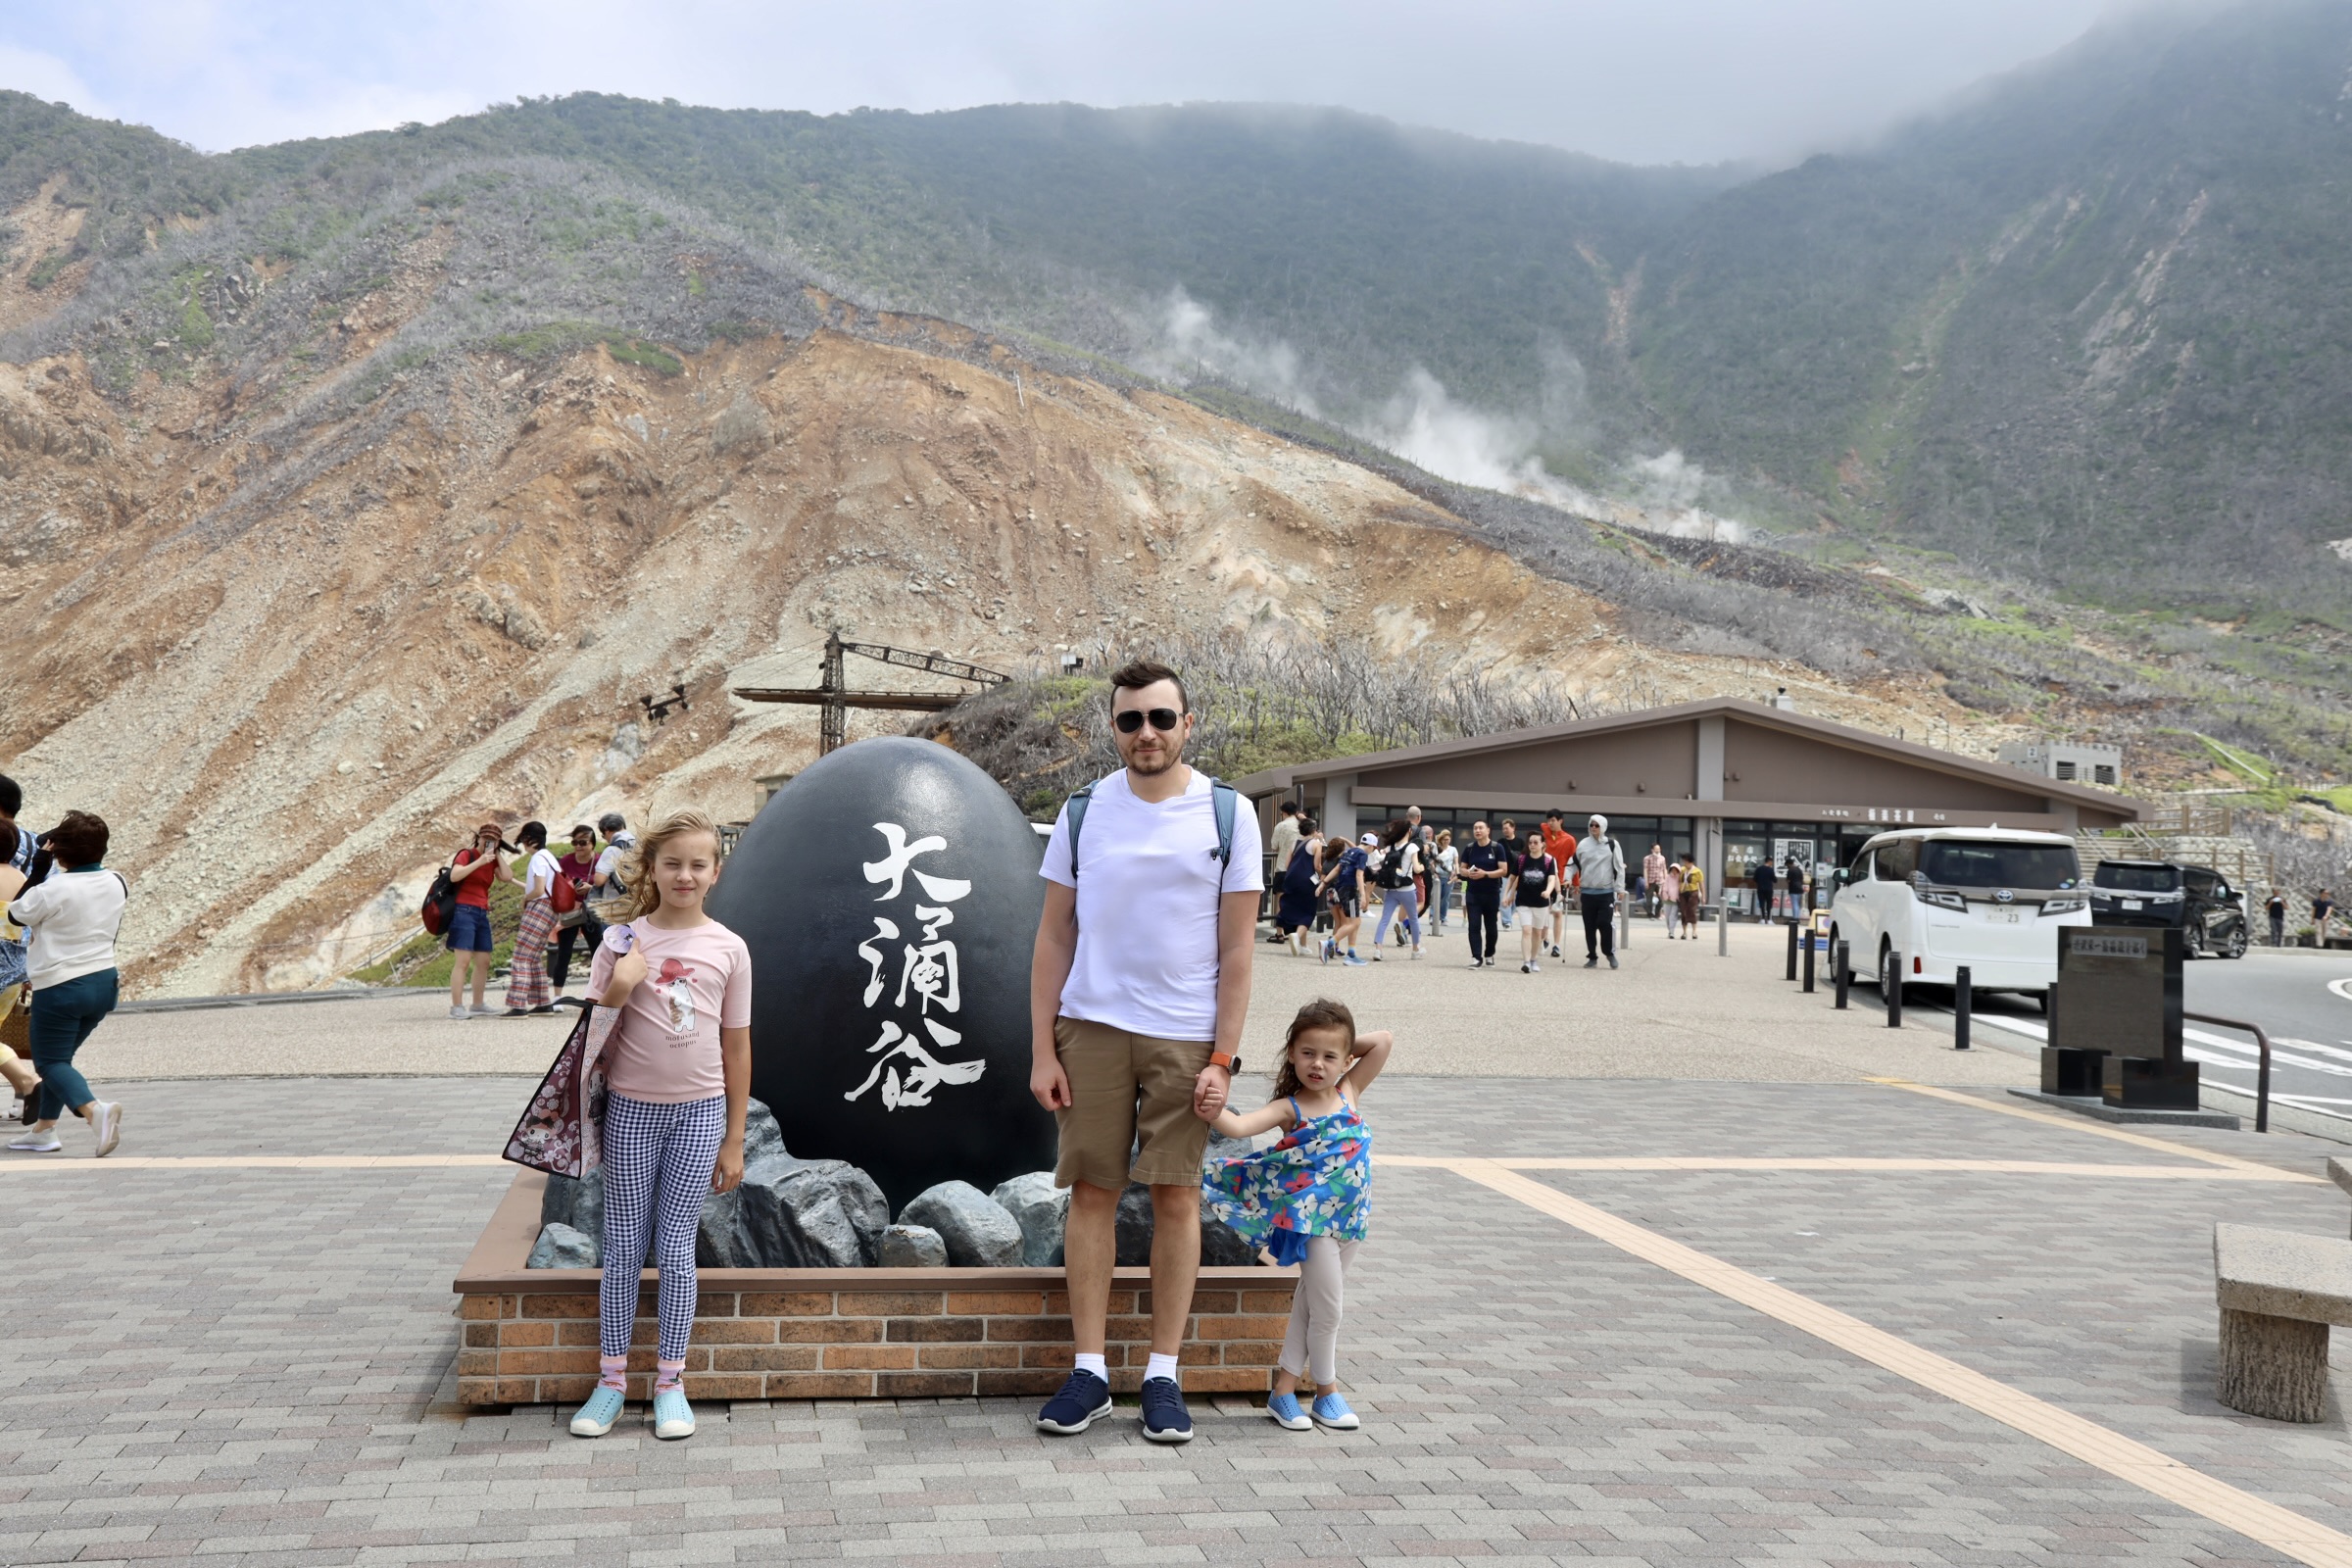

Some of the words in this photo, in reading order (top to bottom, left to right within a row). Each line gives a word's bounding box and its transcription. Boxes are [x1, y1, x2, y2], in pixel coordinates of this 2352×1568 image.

[844, 821, 987, 1112] 大涌谷
[665, 1030, 700, 1042] mofusand
[669, 1039, 697, 1049] octopus
